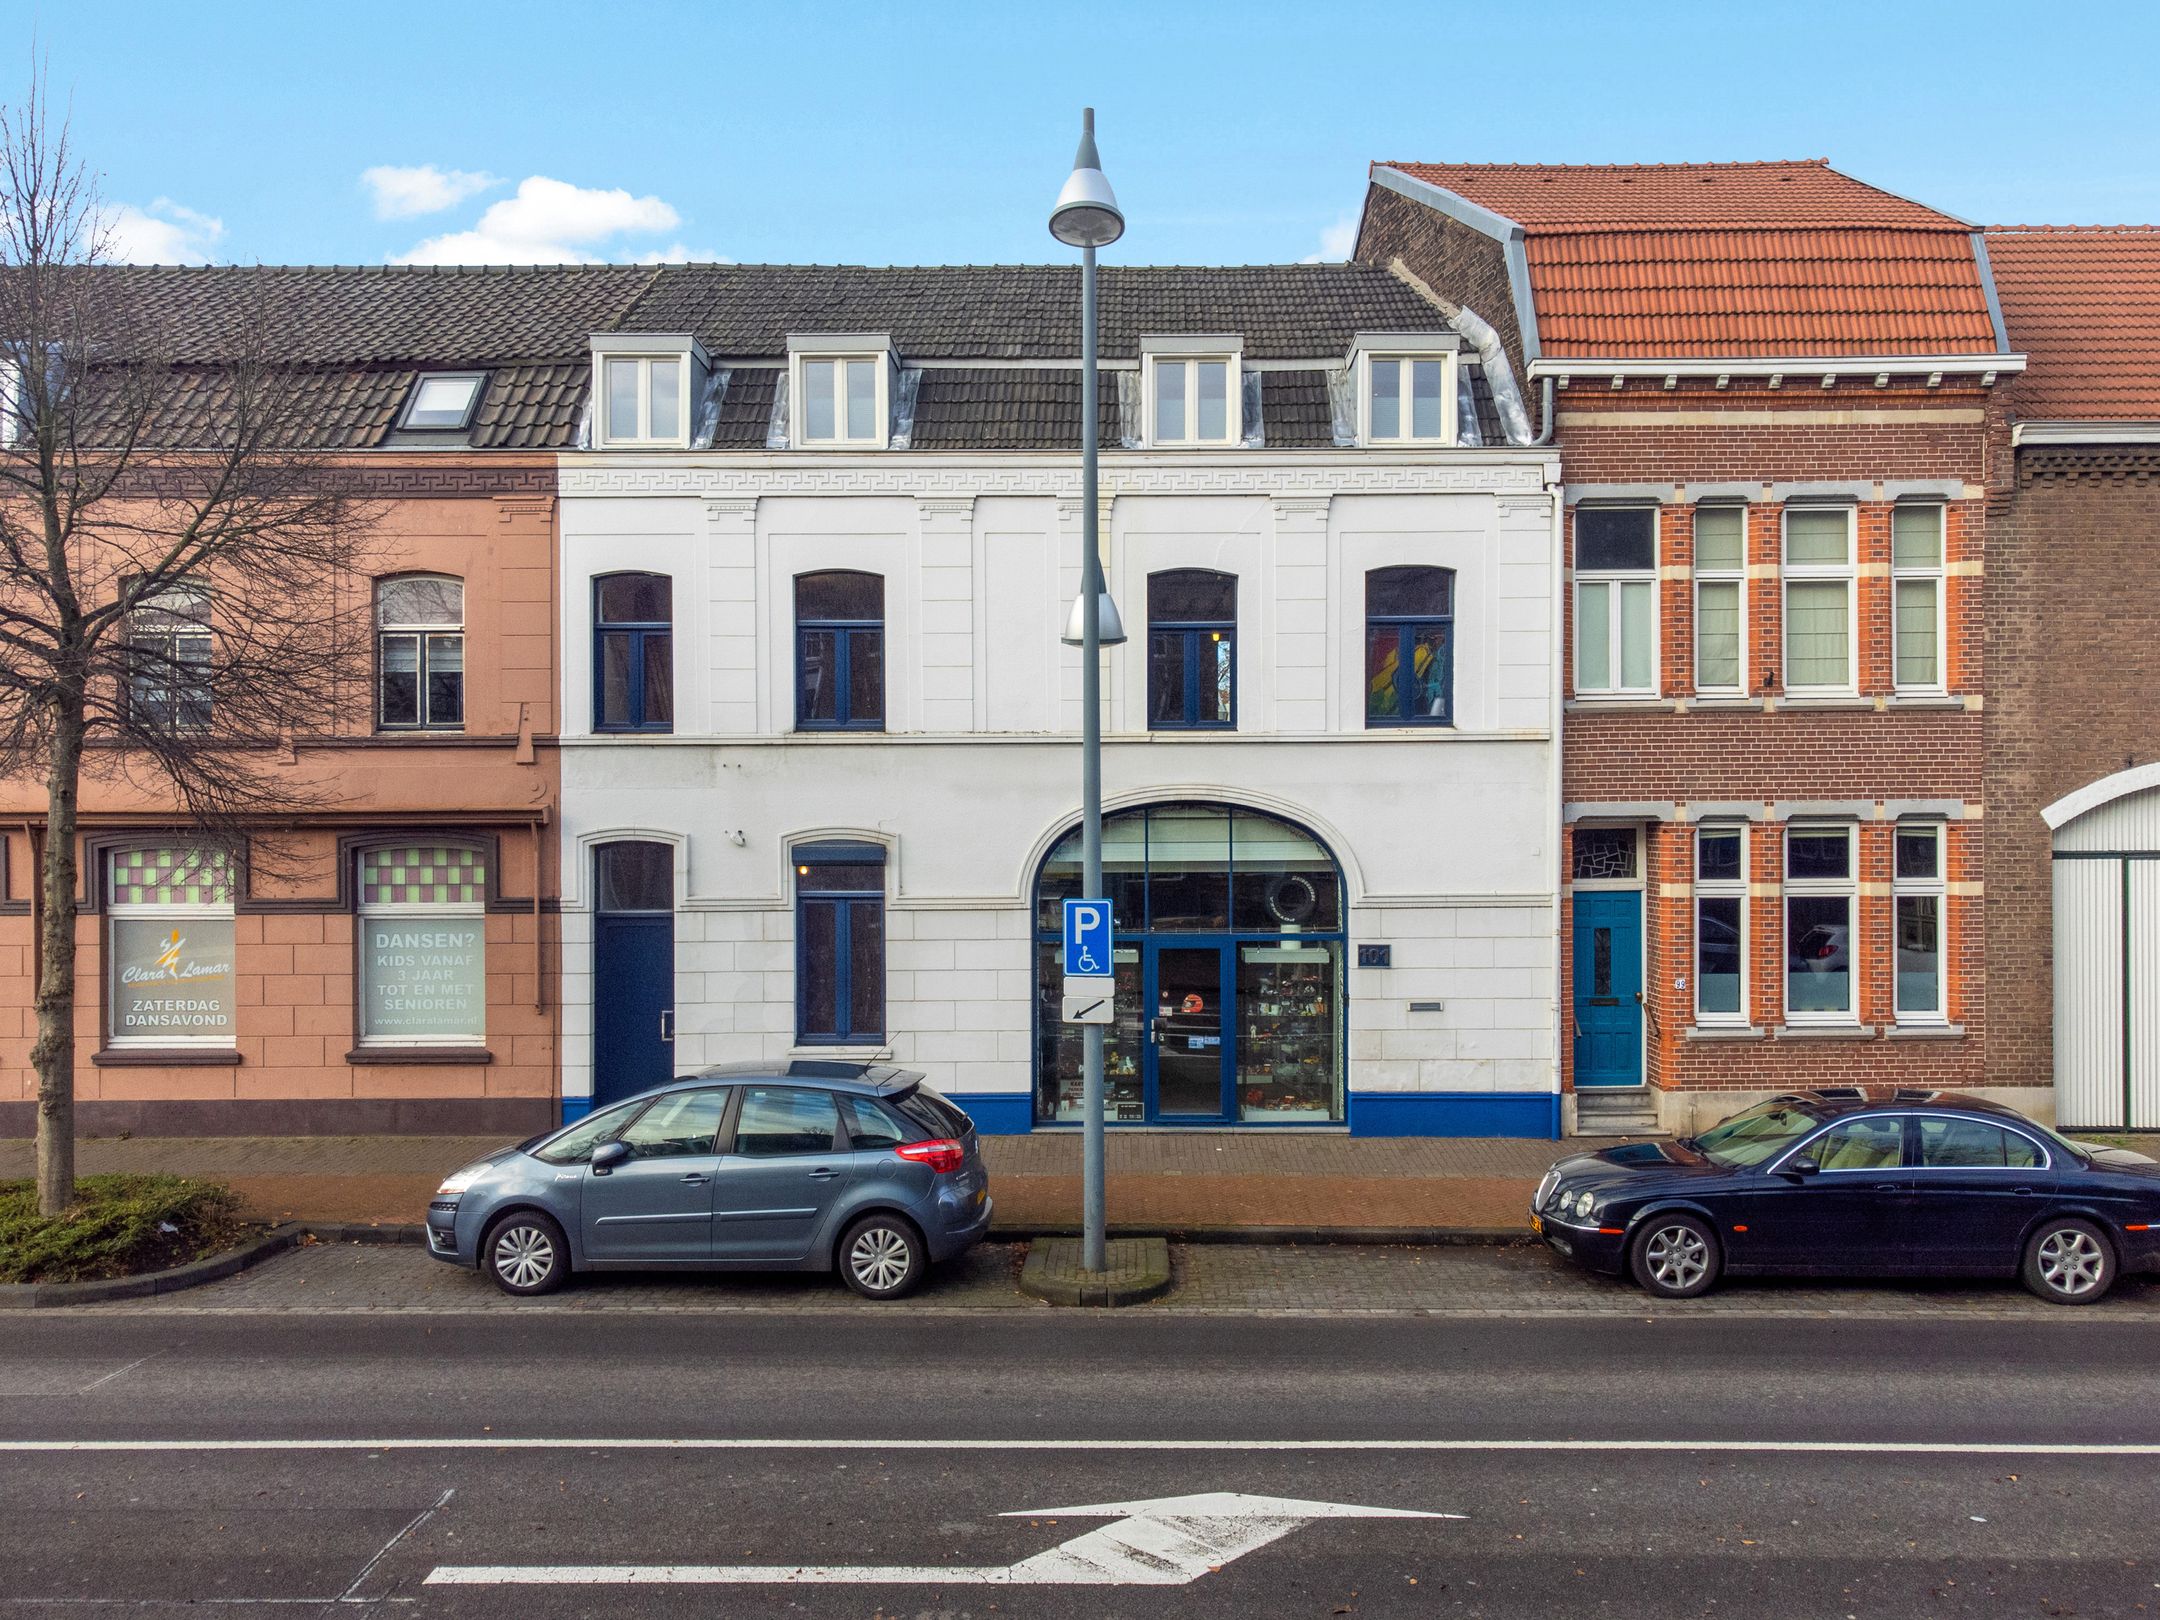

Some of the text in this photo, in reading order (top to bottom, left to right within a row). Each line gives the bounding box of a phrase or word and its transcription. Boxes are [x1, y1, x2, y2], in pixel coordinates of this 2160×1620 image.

[1075, 906, 1101, 945] P
[376, 933, 475, 948] DANSEN?
[378, 955, 473, 966] KIDS VANAF
[122, 966, 166, 983] Clara
[180, 961, 231, 977] Lamar
[398, 970, 454, 981] 3 JAAR
[377, 984, 474, 995] TOT EN MET
[132, 1000, 220, 1011] ZATERDAG
[385, 999, 466, 1010] SENIOREN
[126, 1015, 228, 1026] DANSAVOND
[375, 1016, 478, 1025] www.claralamar.nl
